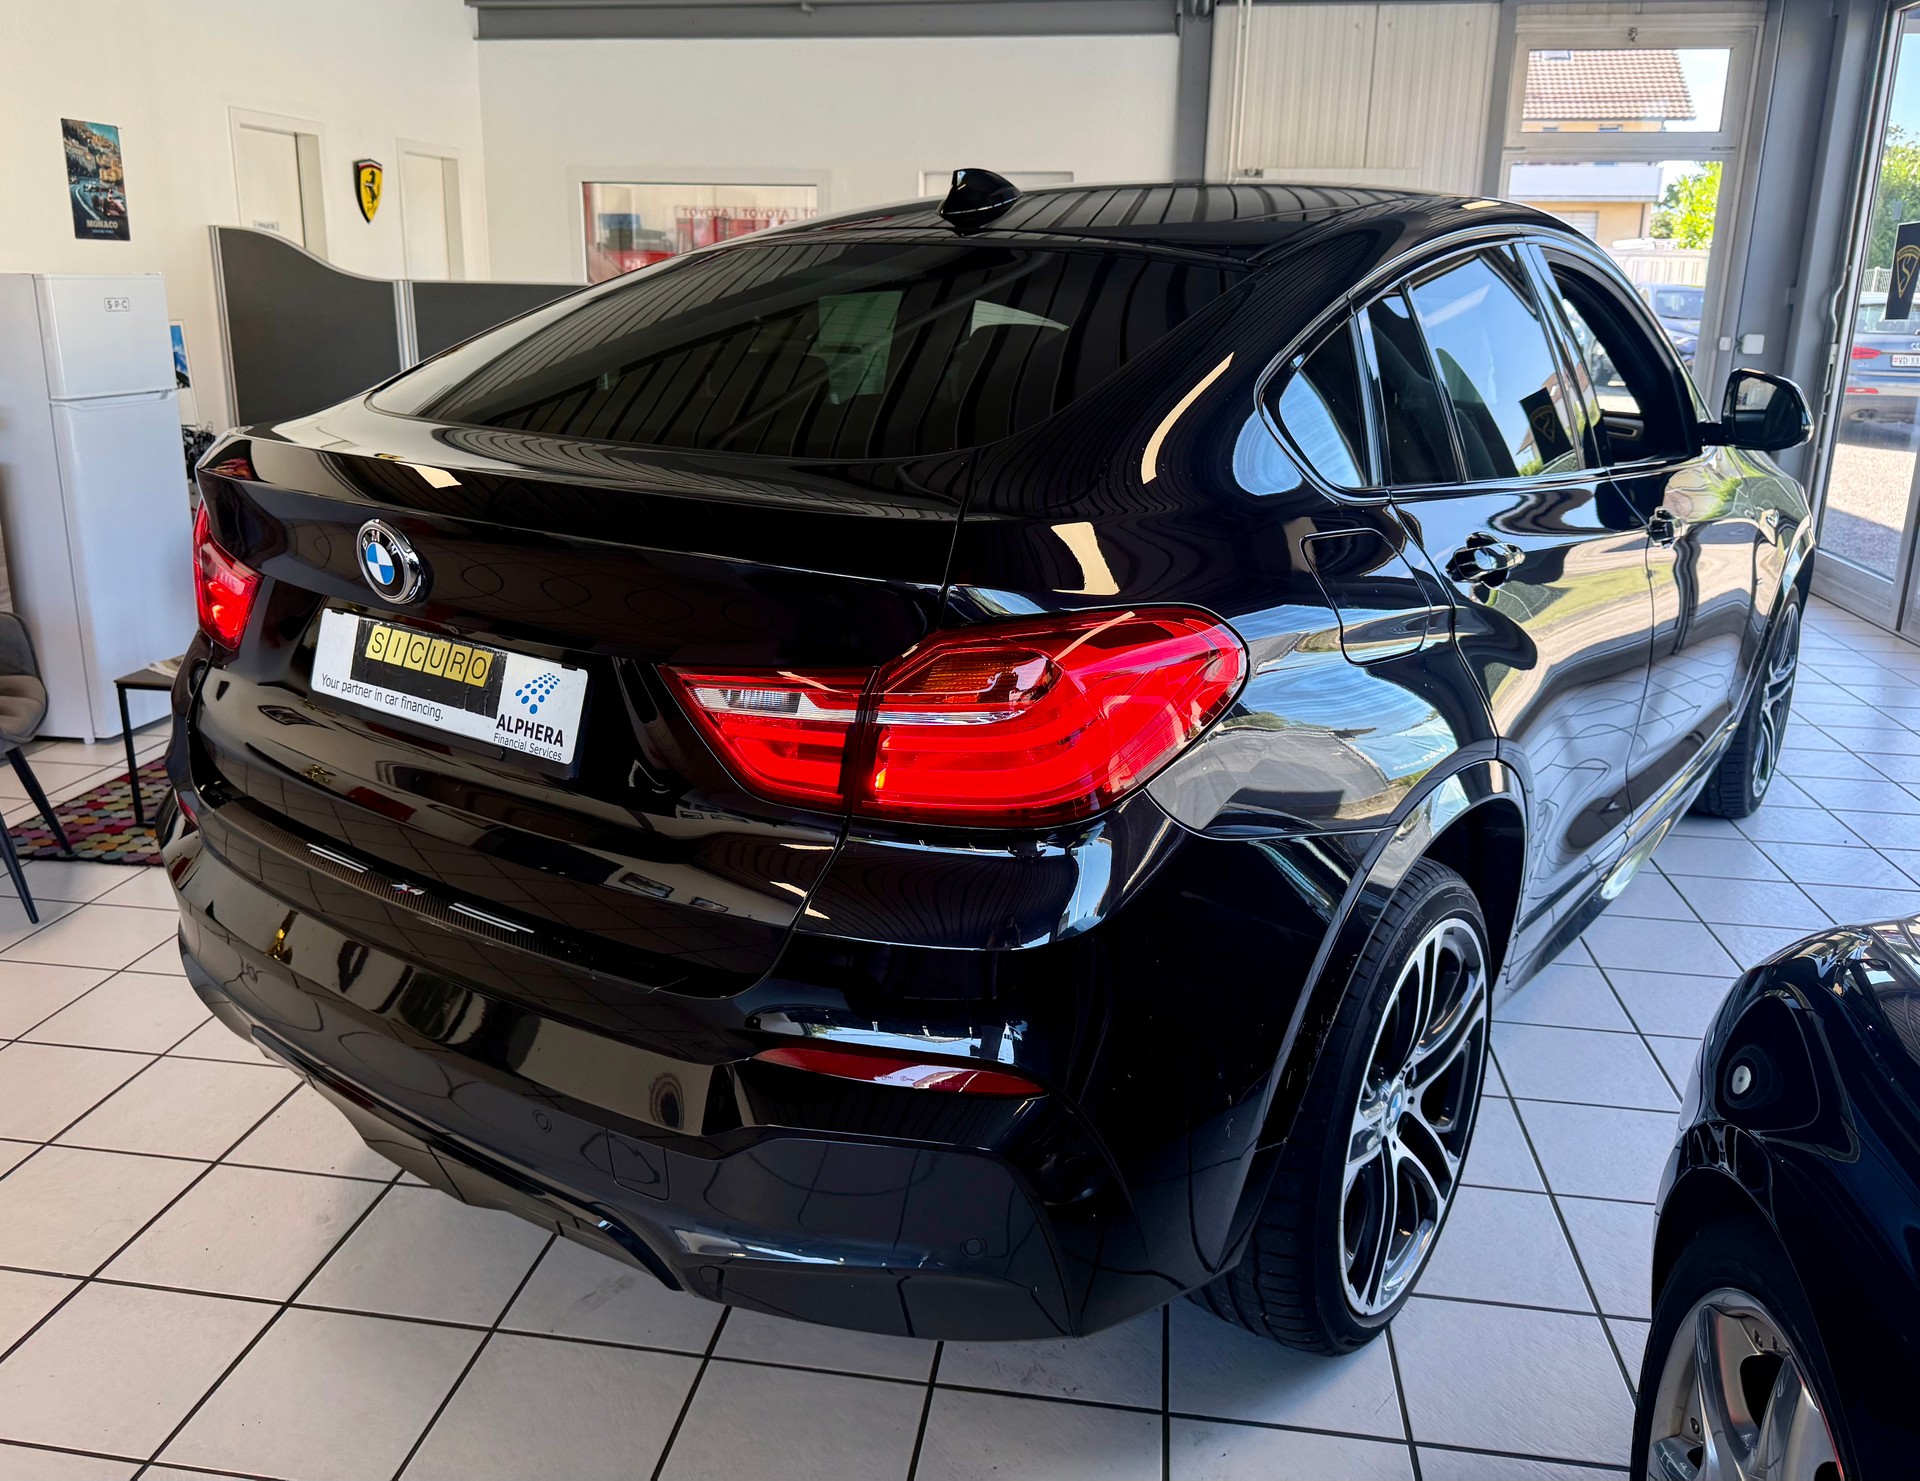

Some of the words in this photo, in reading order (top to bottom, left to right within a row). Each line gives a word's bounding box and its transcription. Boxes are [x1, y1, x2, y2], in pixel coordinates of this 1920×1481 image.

[86, 219, 119, 229] MONACO
[682, 207, 728, 219] TOYOTA
[742, 207, 789, 219] TOYOTA
[361, 529, 399, 557] BMW
[371, 631, 487, 680] SICURO
[321, 673, 341, 690] Your
[341, 681, 373, 699] partner
[374, 688, 383, 702] in
[385, 694, 399, 706] car
[401, 696, 444, 721] financing.
[496, 713, 564, 748] ALPHERA
[493, 732, 528, 751] Financial
[528, 742, 563, 761] Services
